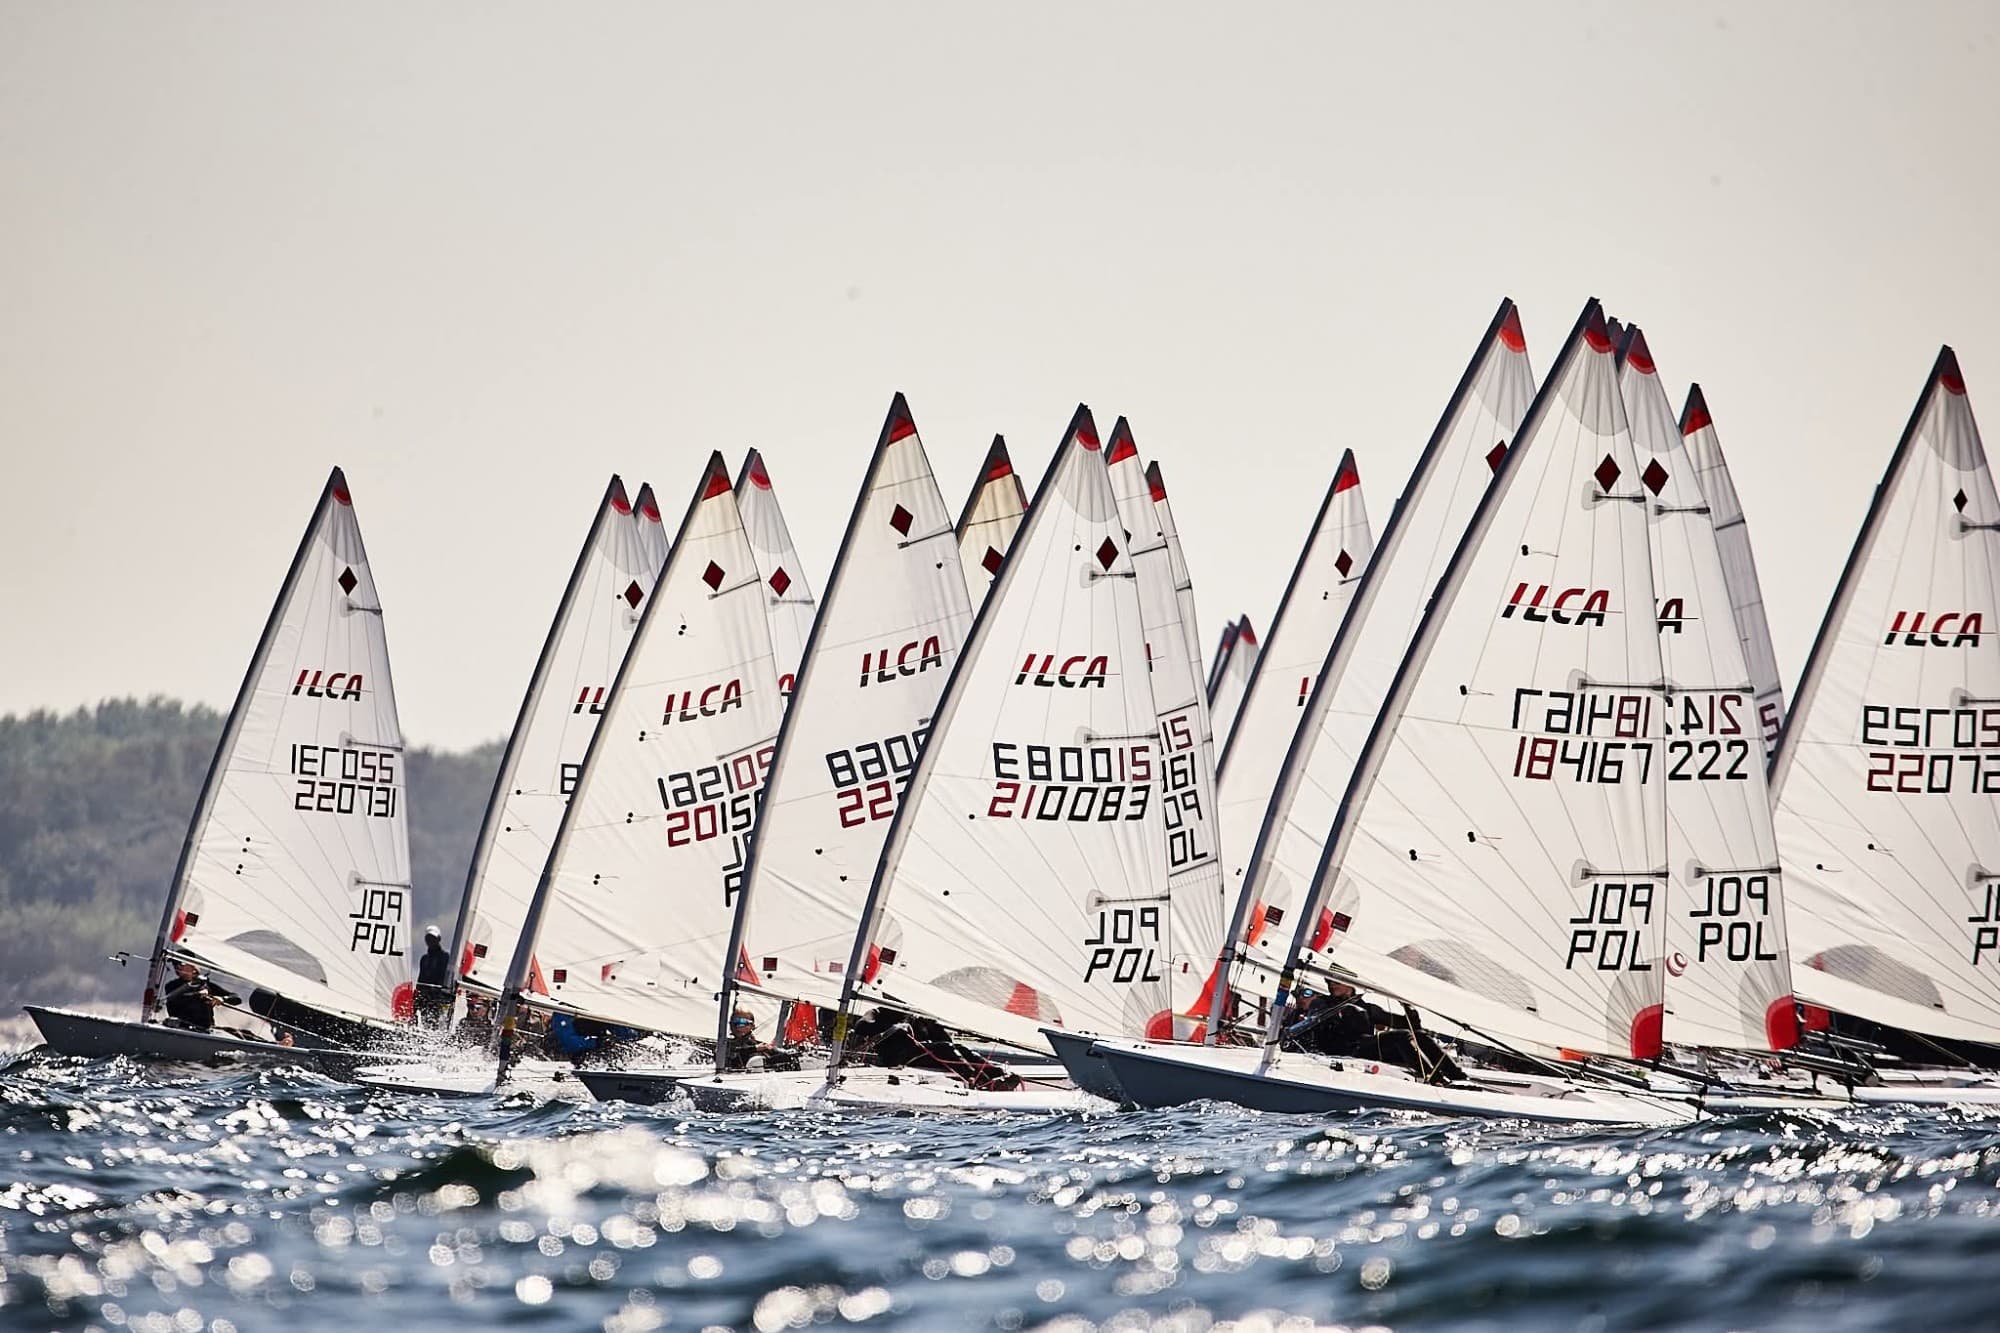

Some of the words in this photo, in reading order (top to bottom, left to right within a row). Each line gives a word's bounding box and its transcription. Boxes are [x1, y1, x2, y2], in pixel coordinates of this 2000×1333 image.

[1501, 582, 1609, 627] ILCA
[1885, 611, 1982, 648] ILCA
[860, 635, 942, 688] ILCA
[1015, 653, 1108, 688] ILCA
[292, 669, 363, 701] ILCA
[573, 687, 605, 714] IL
[663, 679, 742, 726] ILCA
[1513, 736, 1653, 785] 184167
[1668, 739, 1749, 781] 222
[1867, 752, 2000, 794] 22072
[294, 779, 397, 818] 220731
[666, 787, 764, 848] 2015
[987, 782, 1151, 822] 210083
[1168, 828, 1208, 868] OL
[351, 922, 404, 957] POL
[1566, 930, 1652, 971] POL
[1699, 921, 1777, 962] POL
[1084, 948, 1161, 983] POL
